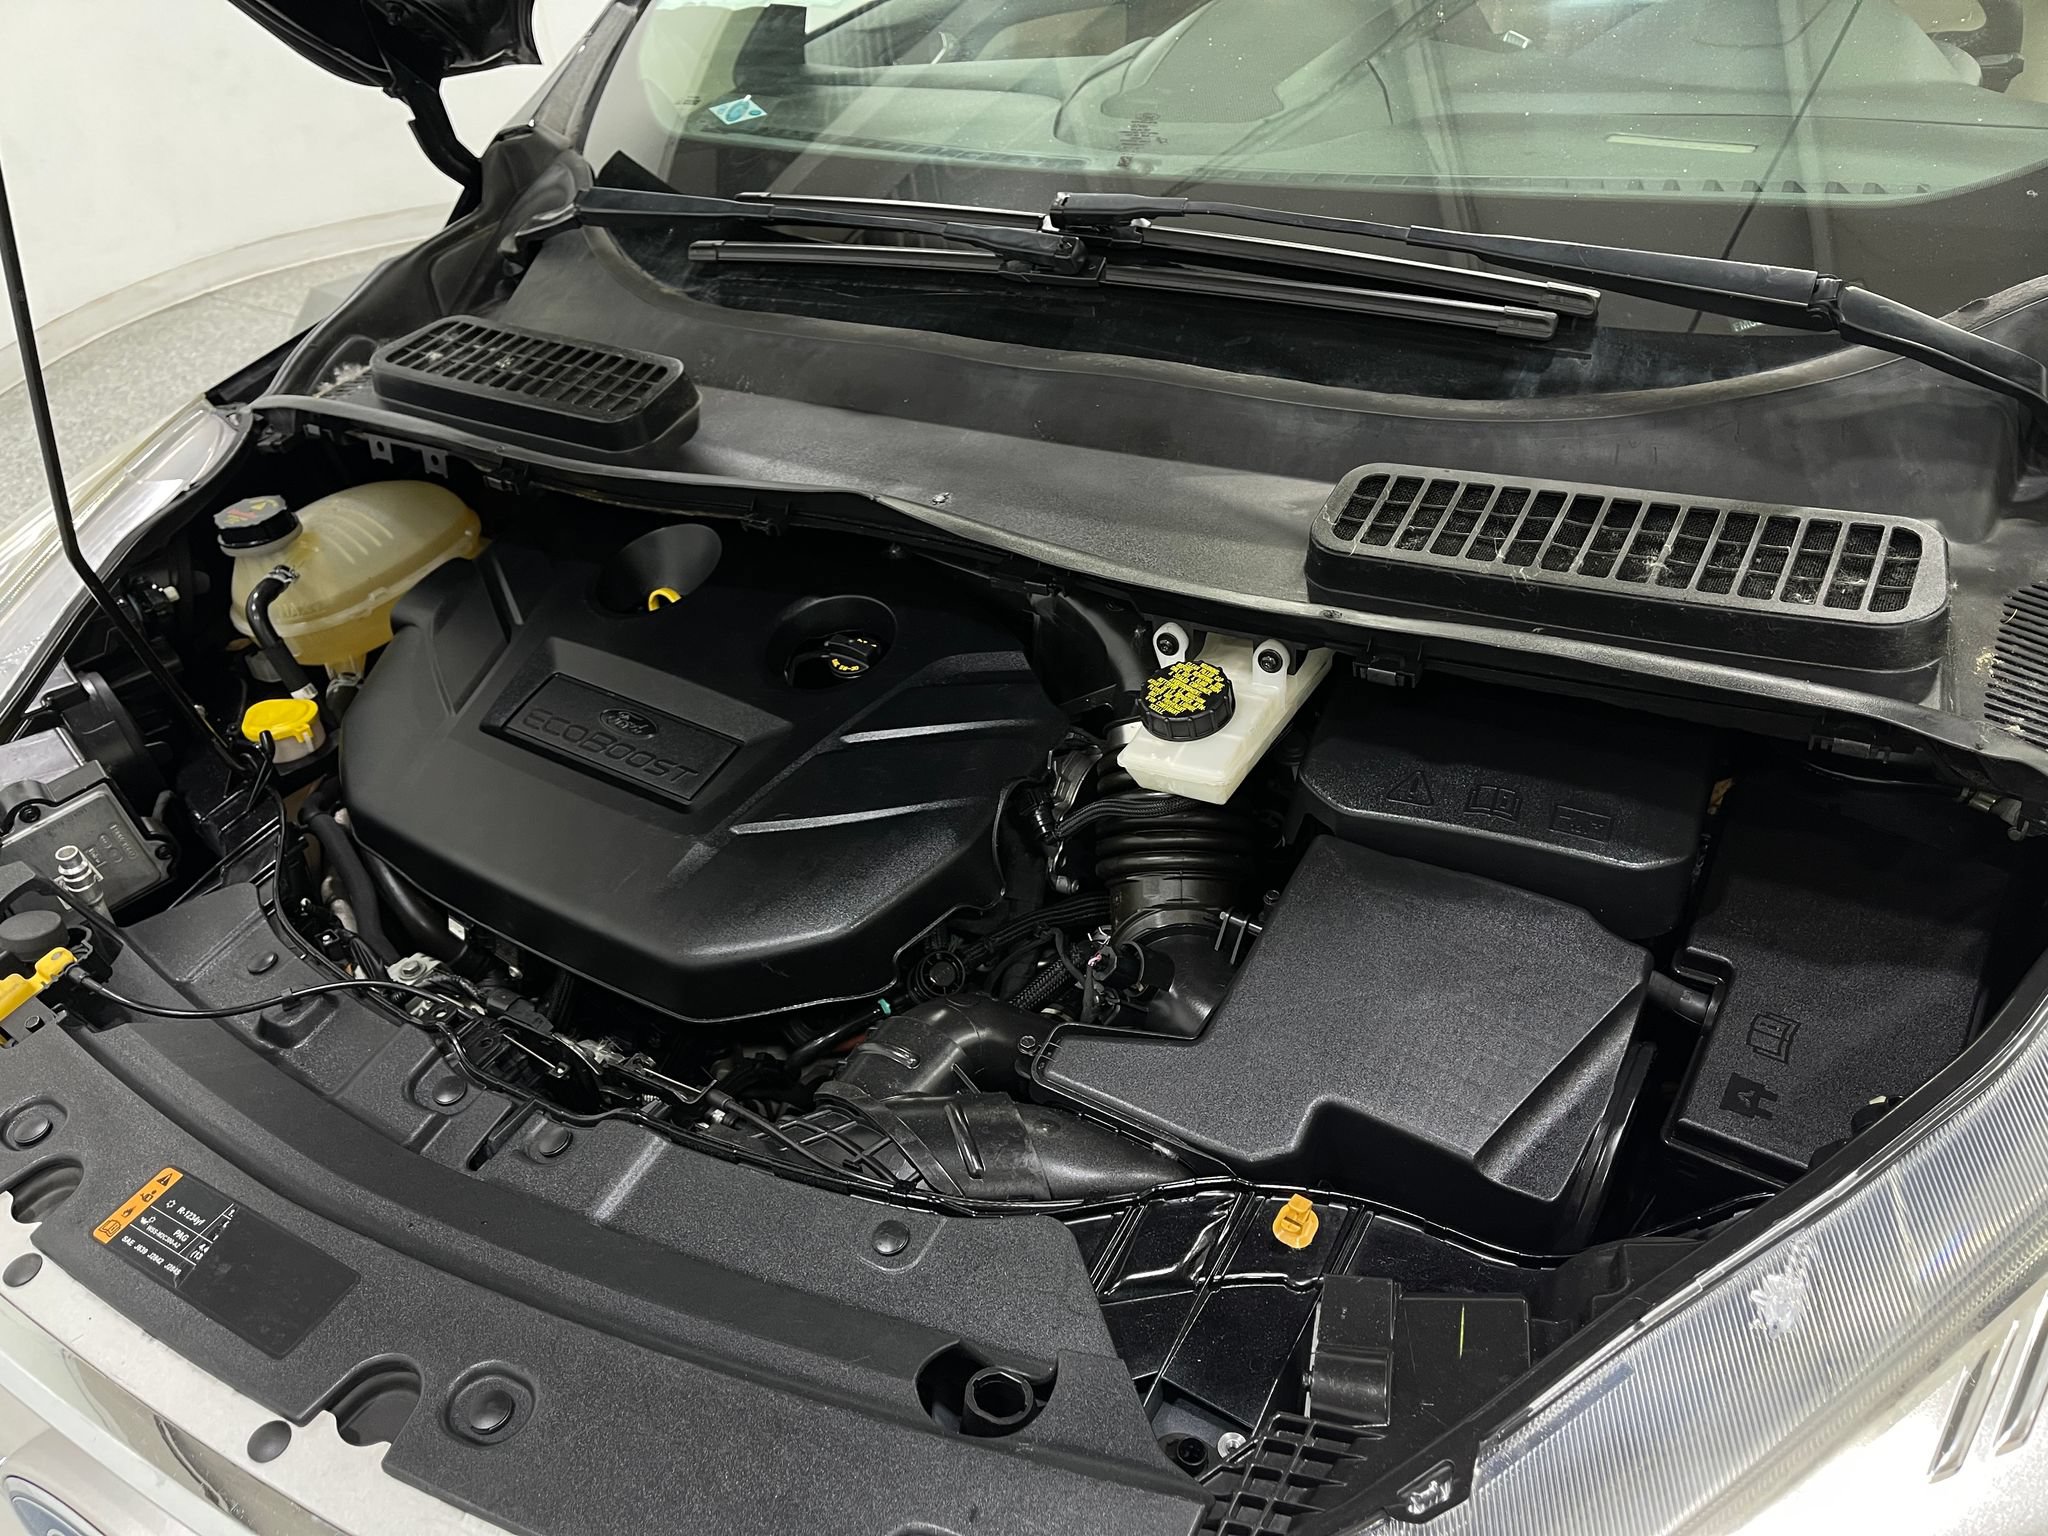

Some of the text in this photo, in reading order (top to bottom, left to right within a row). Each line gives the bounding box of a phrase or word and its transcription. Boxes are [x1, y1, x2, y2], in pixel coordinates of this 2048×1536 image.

[522, 707, 699, 784] ECOBOOST
[176, 1206, 206, 1226] R-1234yf
[121, 1235, 136, 1247] SAE
[173, 1229, 190, 1242] PAG
